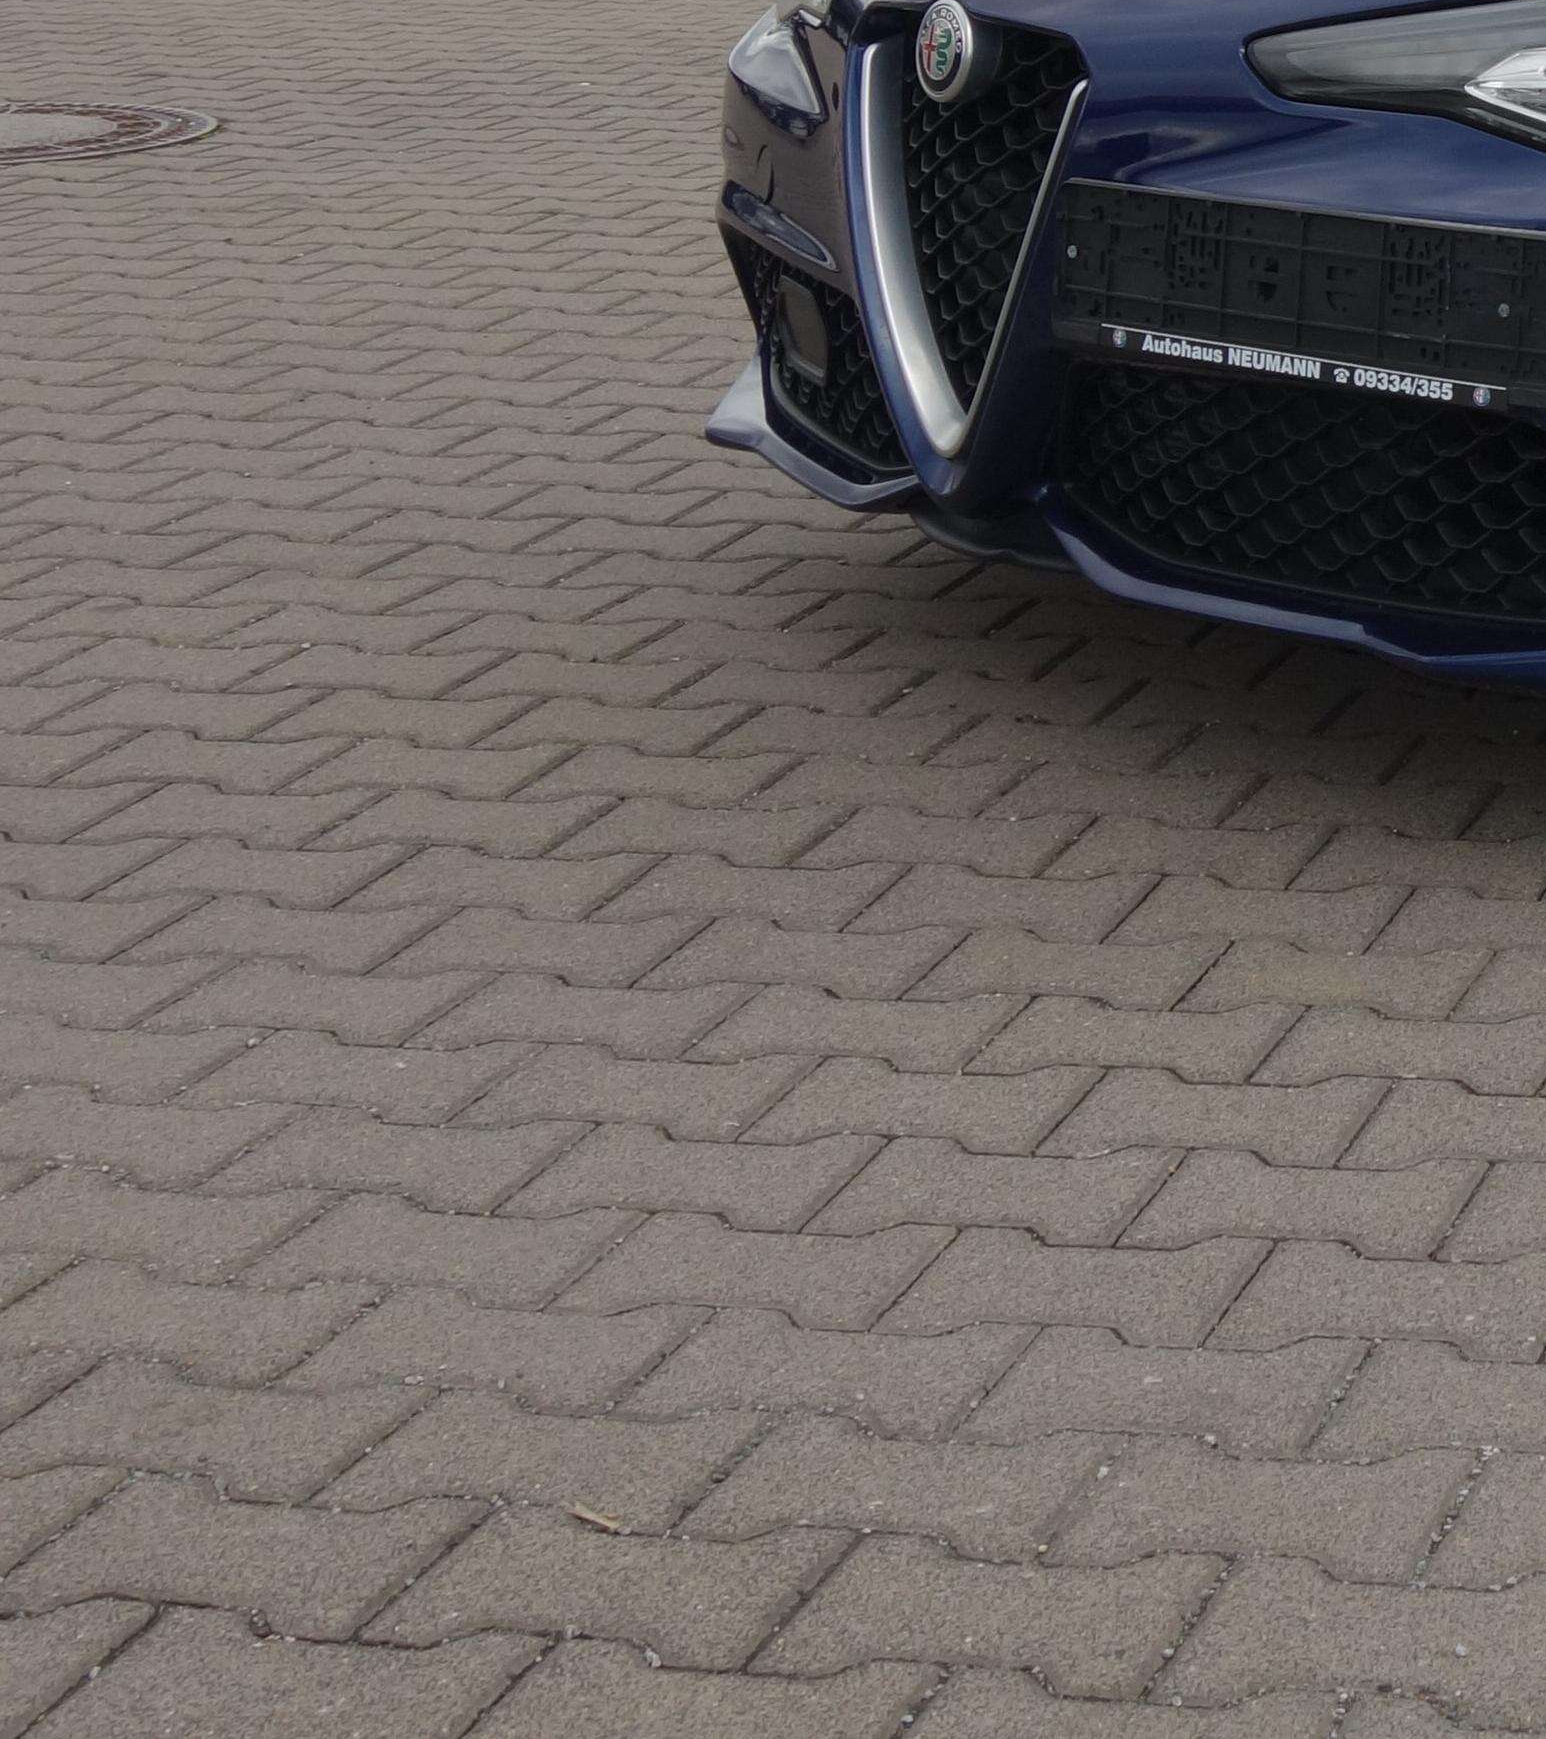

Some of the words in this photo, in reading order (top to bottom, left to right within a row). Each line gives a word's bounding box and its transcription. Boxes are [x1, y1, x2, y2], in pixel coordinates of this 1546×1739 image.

[1142, 334, 1223, 363] Autohaus
[1228, 348, 1321, 380] NEUMANN
[1353, 368, 1453, 401] 09334/355
